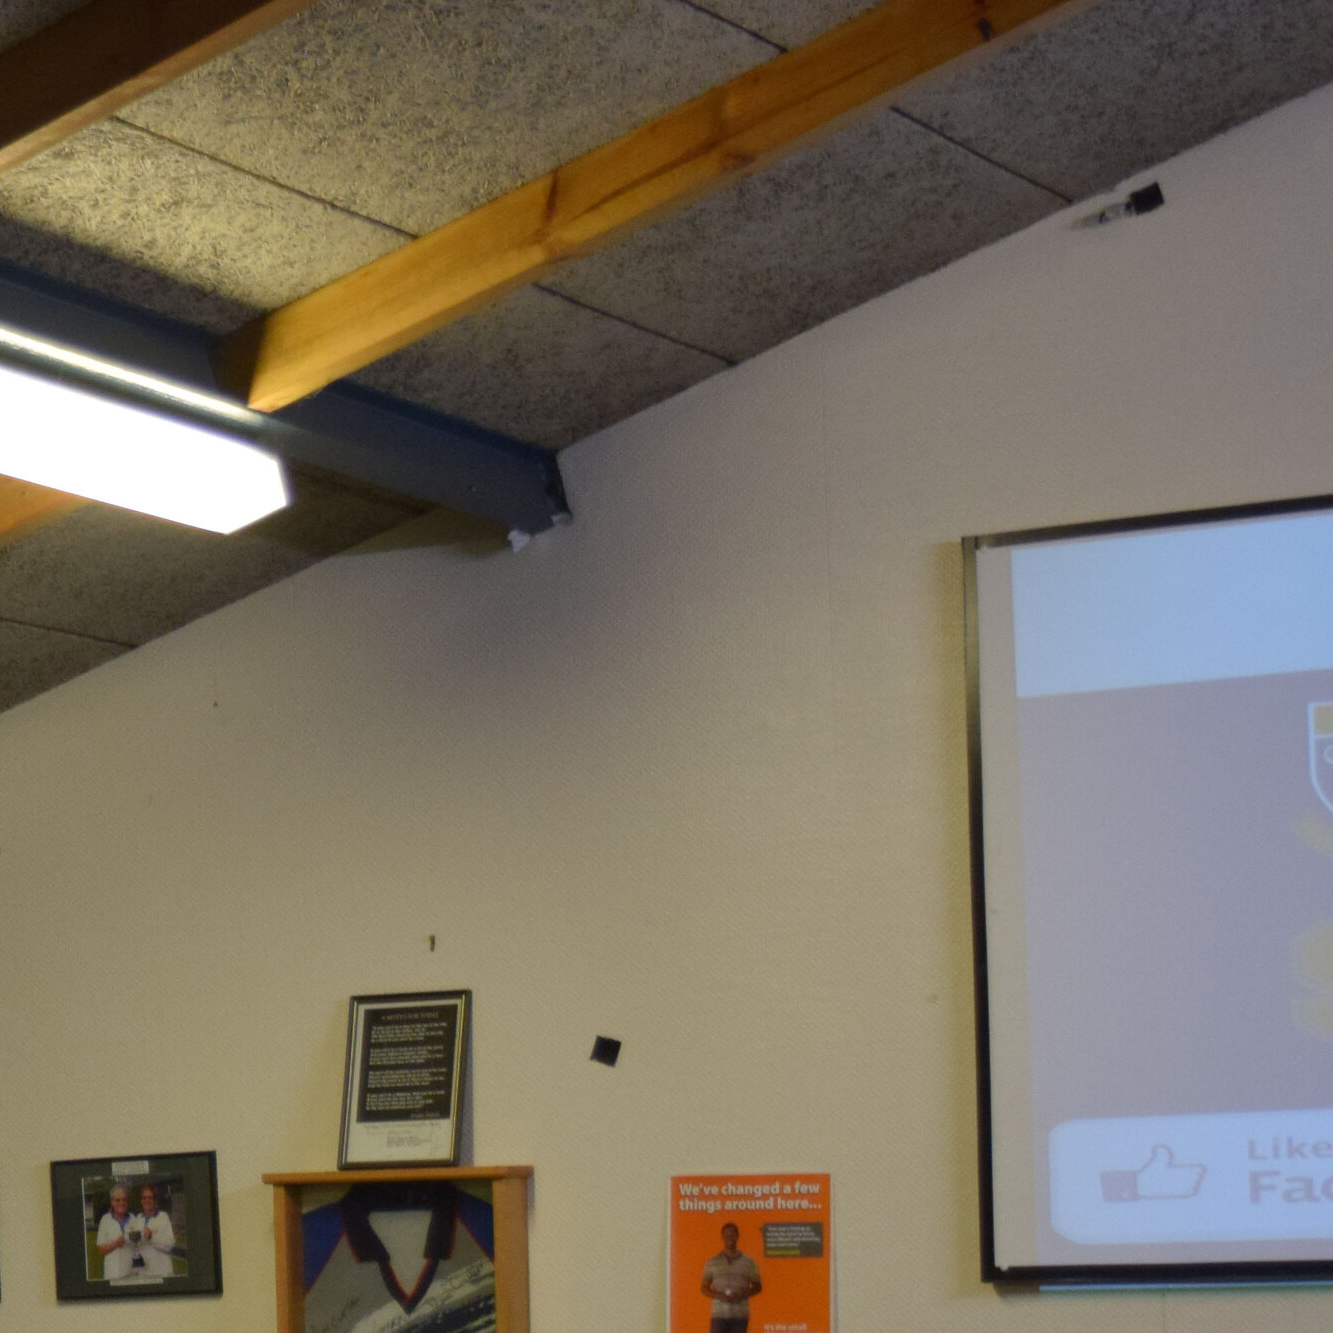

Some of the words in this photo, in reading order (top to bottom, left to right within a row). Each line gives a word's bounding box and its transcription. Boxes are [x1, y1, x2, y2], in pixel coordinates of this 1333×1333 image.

[1247, 1136, 1332, 1160] Like
[679, 1184, 718, 1196] We've
[721, 1182, 780, 1198] changed
[783, 1185, 791, 1194] a
[795, 1181, 820, 1194] few
[678, 1197, 722, 1214] things
[724, 1197, 773, 1210] around
[777, 1197, 821, 1210] here...
